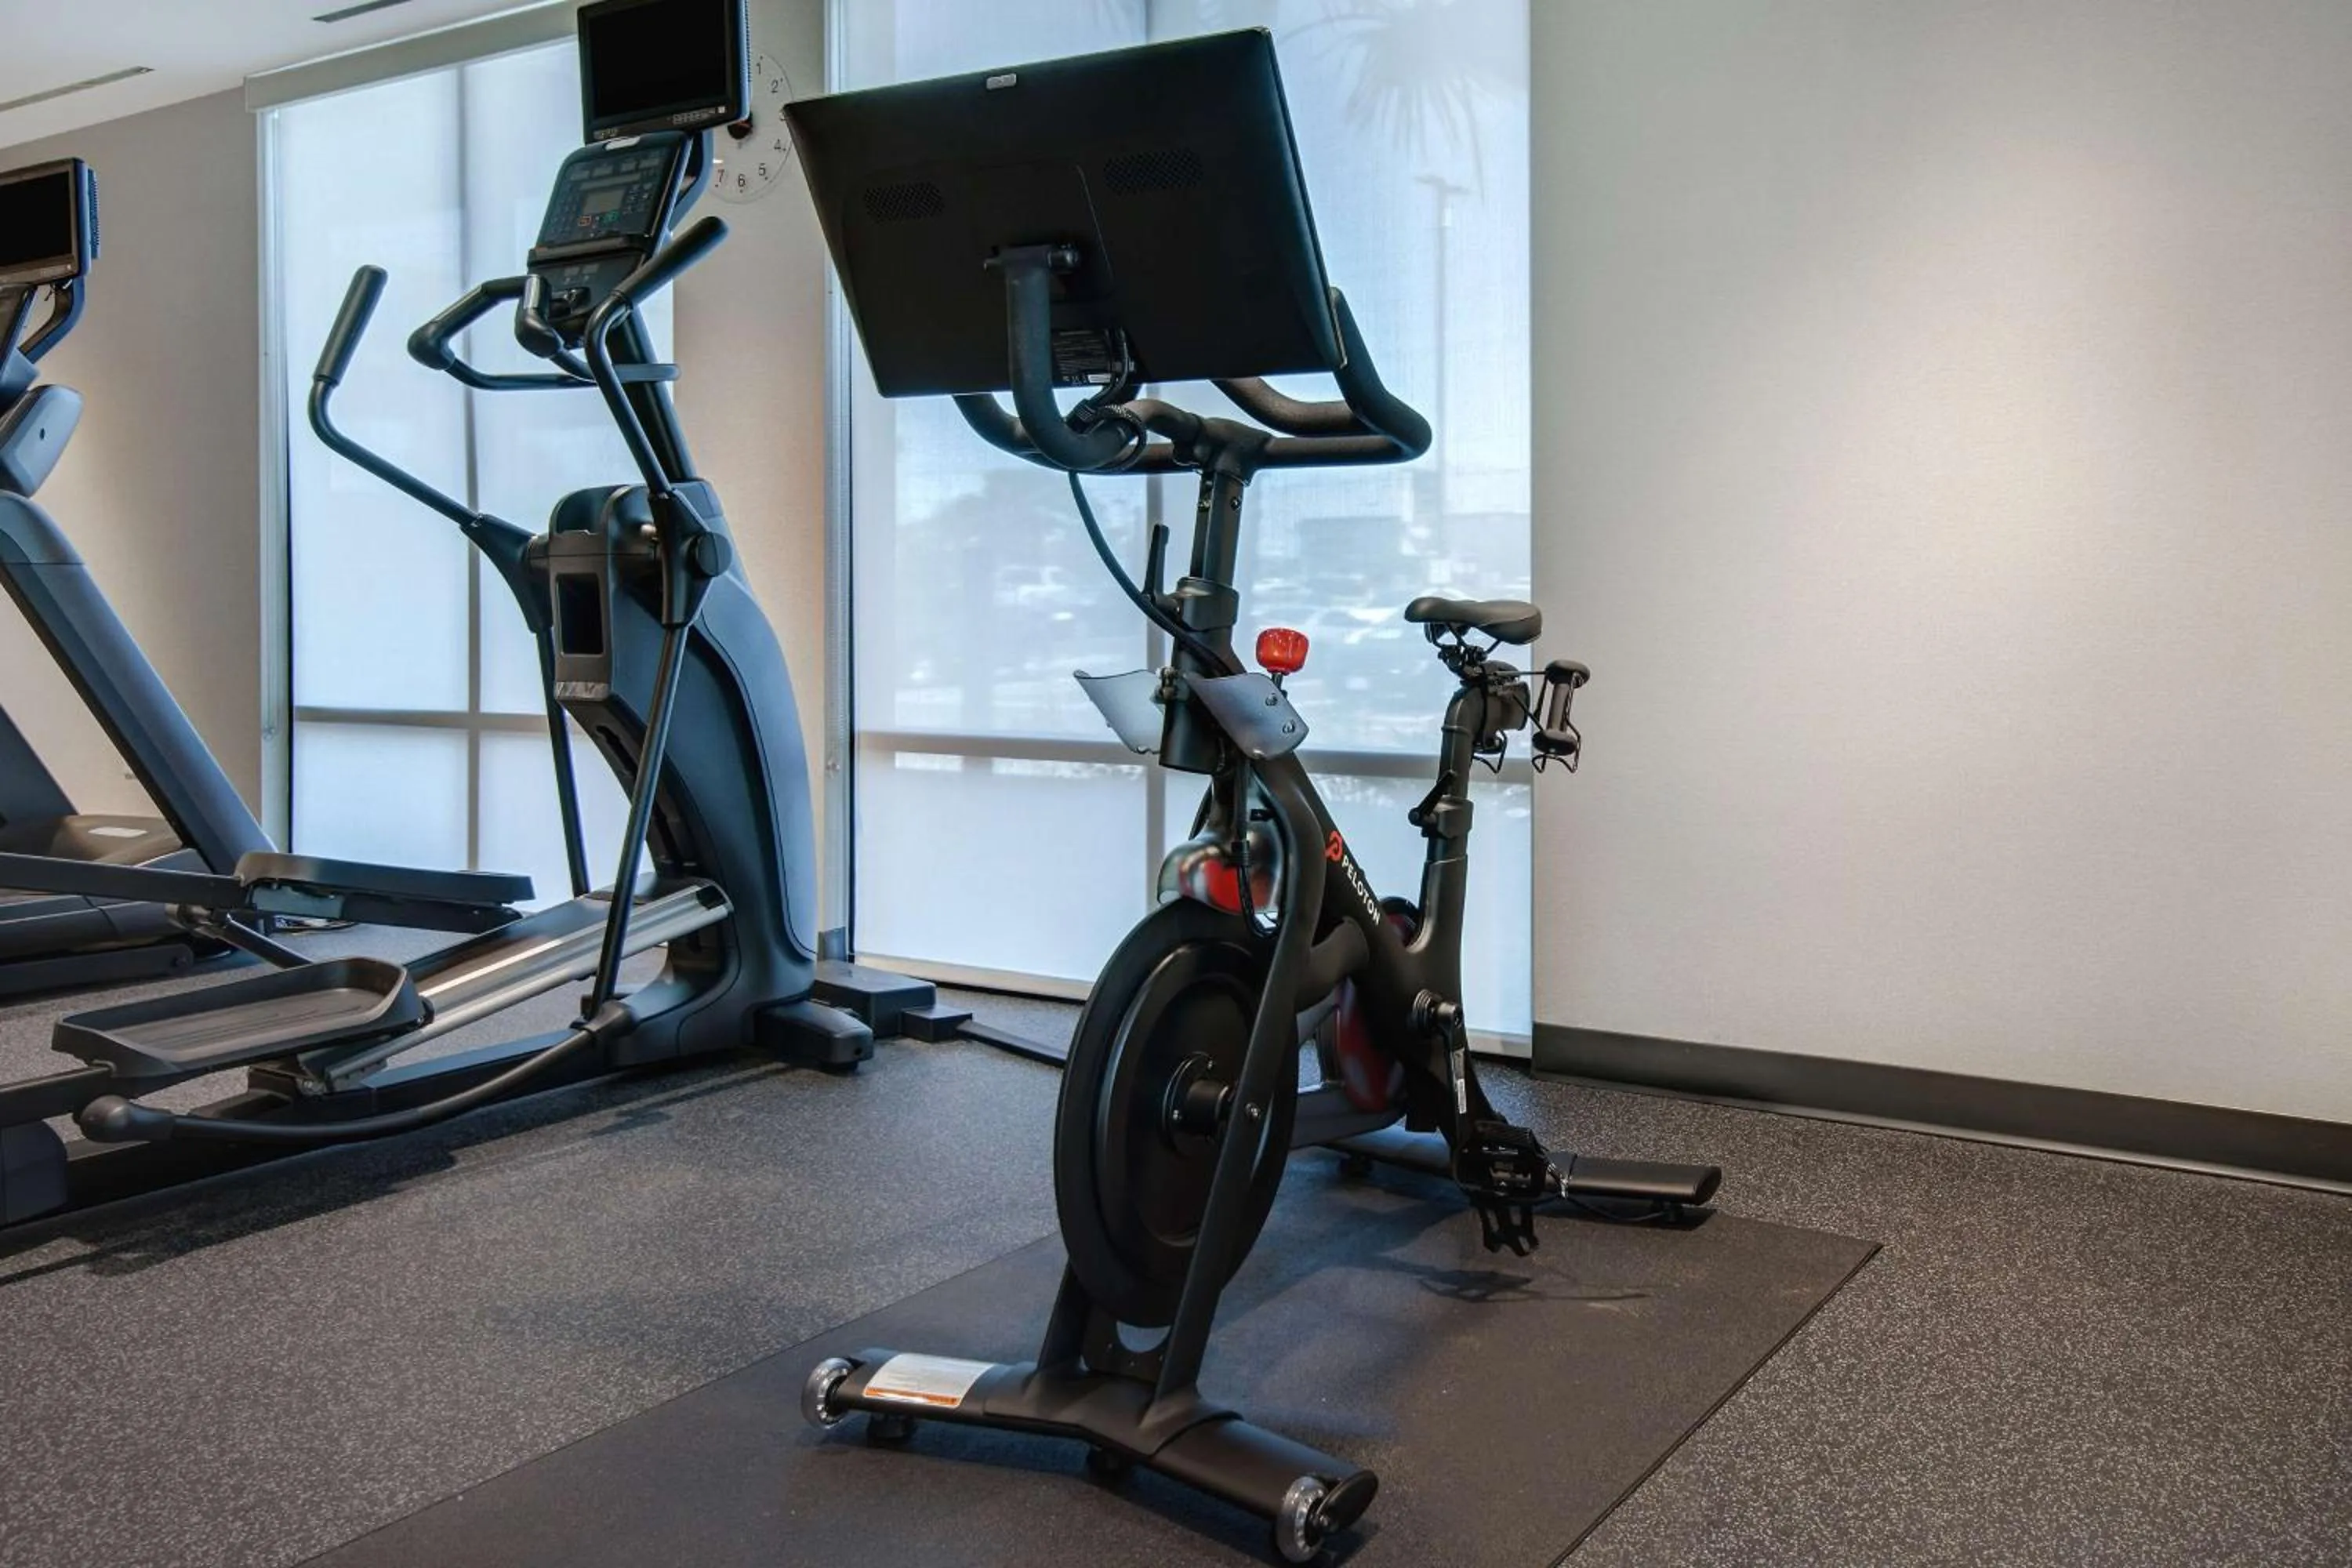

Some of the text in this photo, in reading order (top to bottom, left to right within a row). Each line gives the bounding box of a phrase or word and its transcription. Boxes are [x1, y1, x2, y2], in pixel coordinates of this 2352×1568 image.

[771, 79, 779, 93] 2
[774, 139, 781, 150] 4
[717, 169, 725, 183] 7
[758, 163, 766, 176] 5
[738, 174, 746, 187] 6
[1341, 855, 1381, 926] PELOTON
